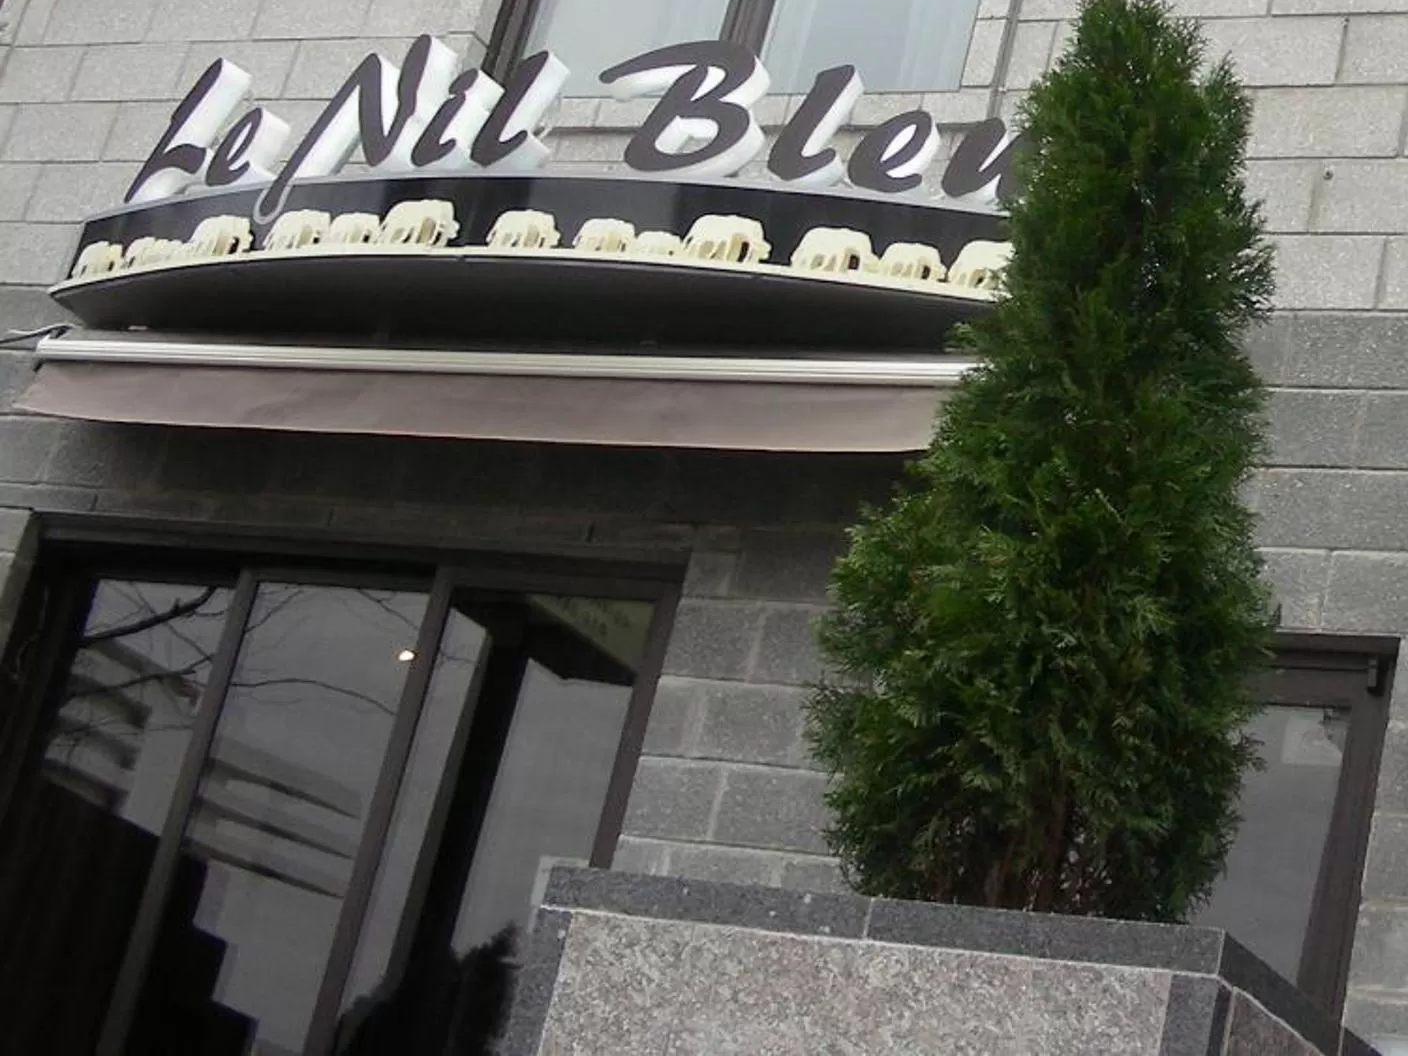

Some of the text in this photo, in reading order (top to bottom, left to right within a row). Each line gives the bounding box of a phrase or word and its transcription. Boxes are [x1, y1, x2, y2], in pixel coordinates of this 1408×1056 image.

[123, 34, 1028, 221] Le Nil Bleu
